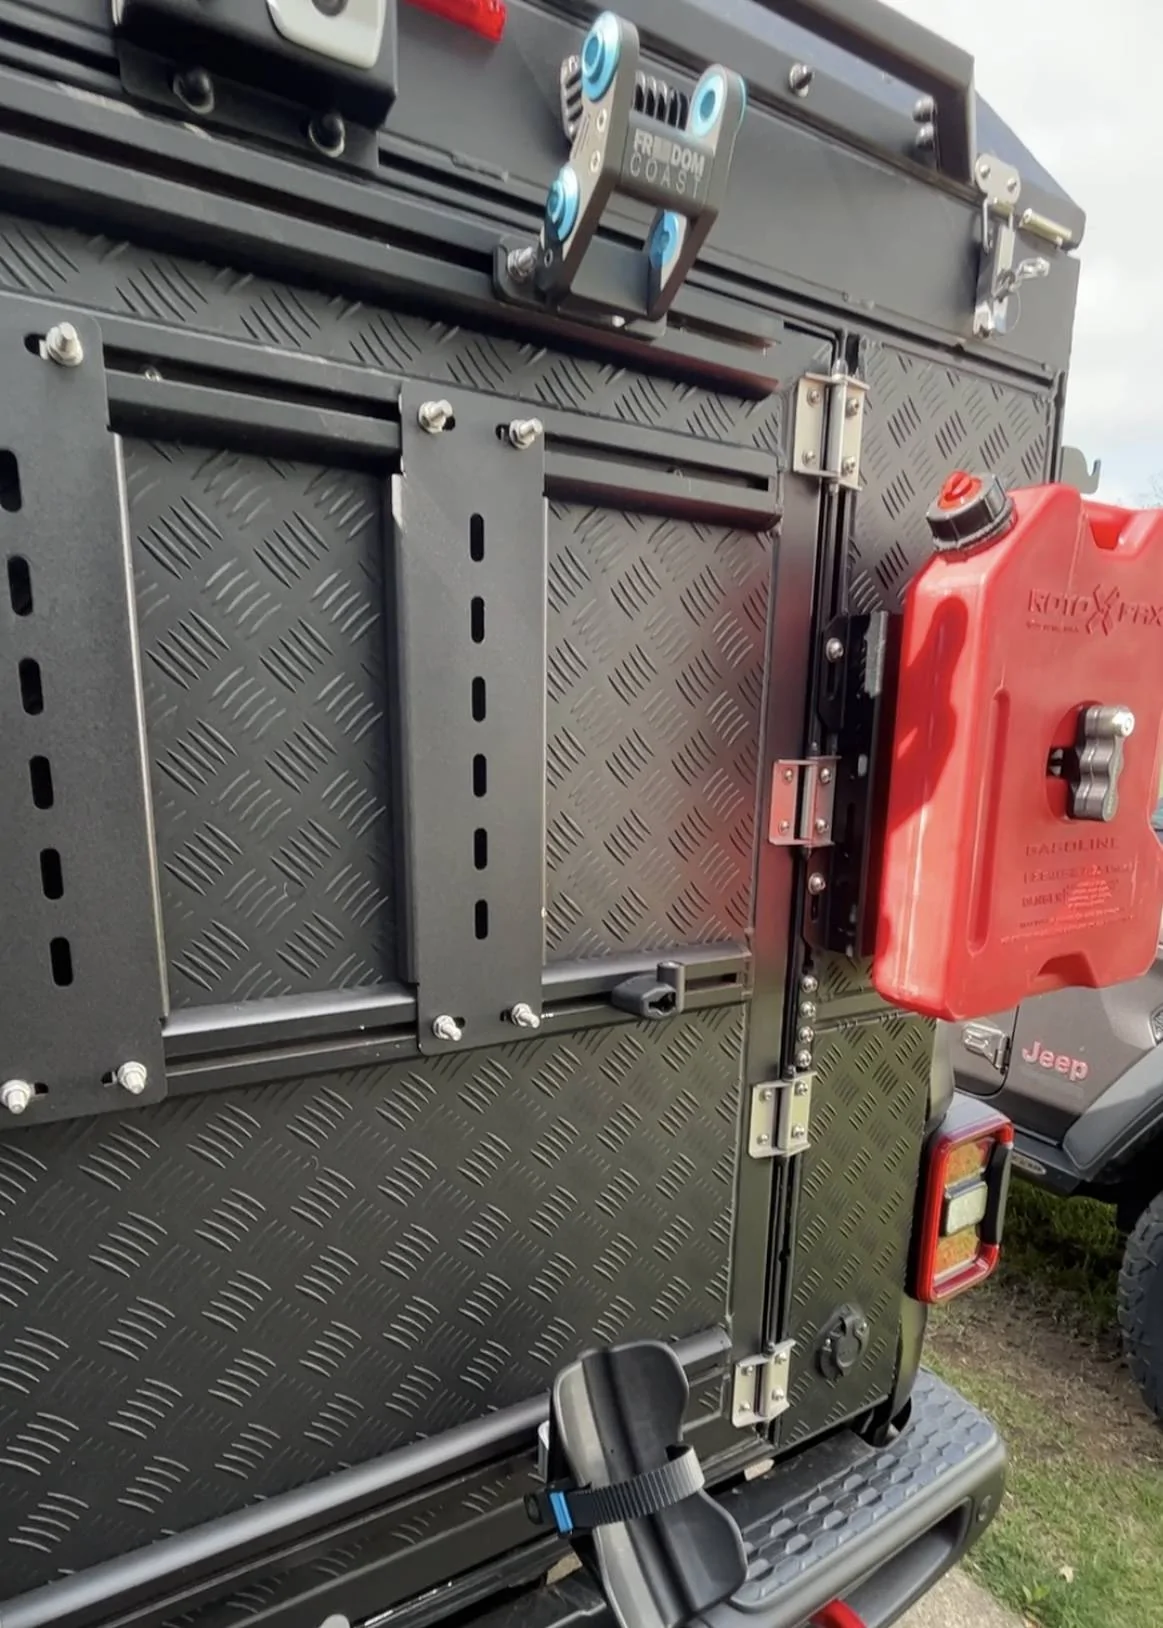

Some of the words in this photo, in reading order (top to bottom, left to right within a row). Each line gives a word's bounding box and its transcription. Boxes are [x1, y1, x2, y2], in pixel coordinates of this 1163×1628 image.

[630, 152, 702, 199] COAST
[633, 128, 705, 177] FRDOM
[1021, 1040, 1090, 1082] Jeep
